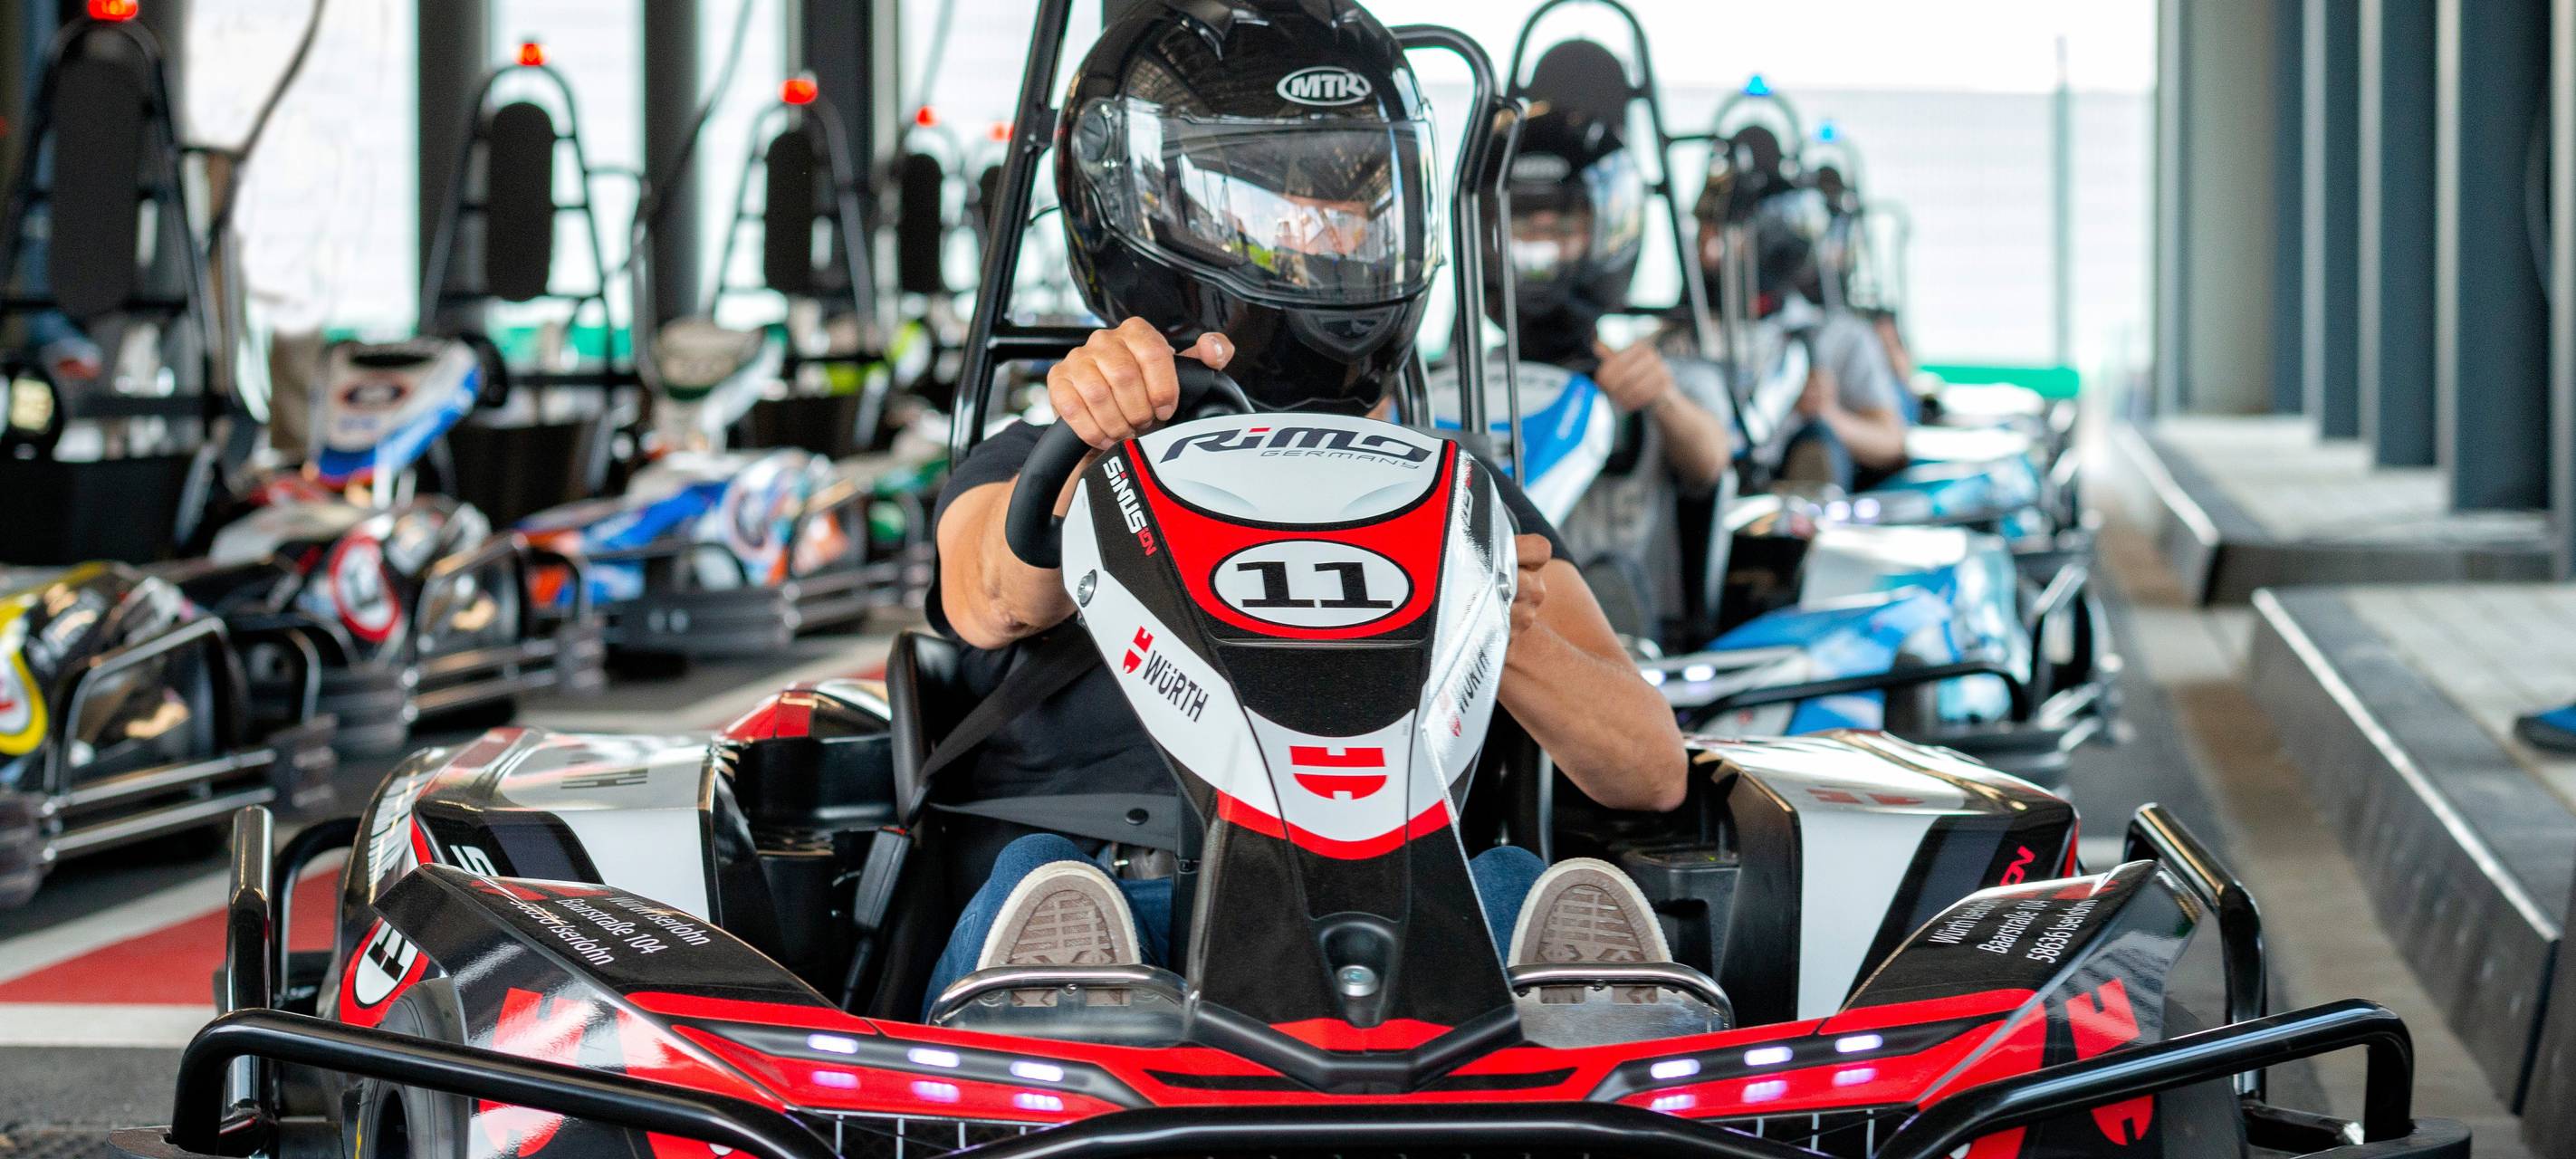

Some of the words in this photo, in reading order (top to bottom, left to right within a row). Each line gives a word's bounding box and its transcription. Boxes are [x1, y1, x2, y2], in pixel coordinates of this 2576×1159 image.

[1260, 451, 1420, 469] GERMANY
[1237, 561, 1393, 608] 11
[1143, 650, 1209, 723] WÜRTH
[547, 925, 615, 965] Iserlohn
[624, 934, 668, 954] 104
[2025, 932, 2073, 963] 58636
